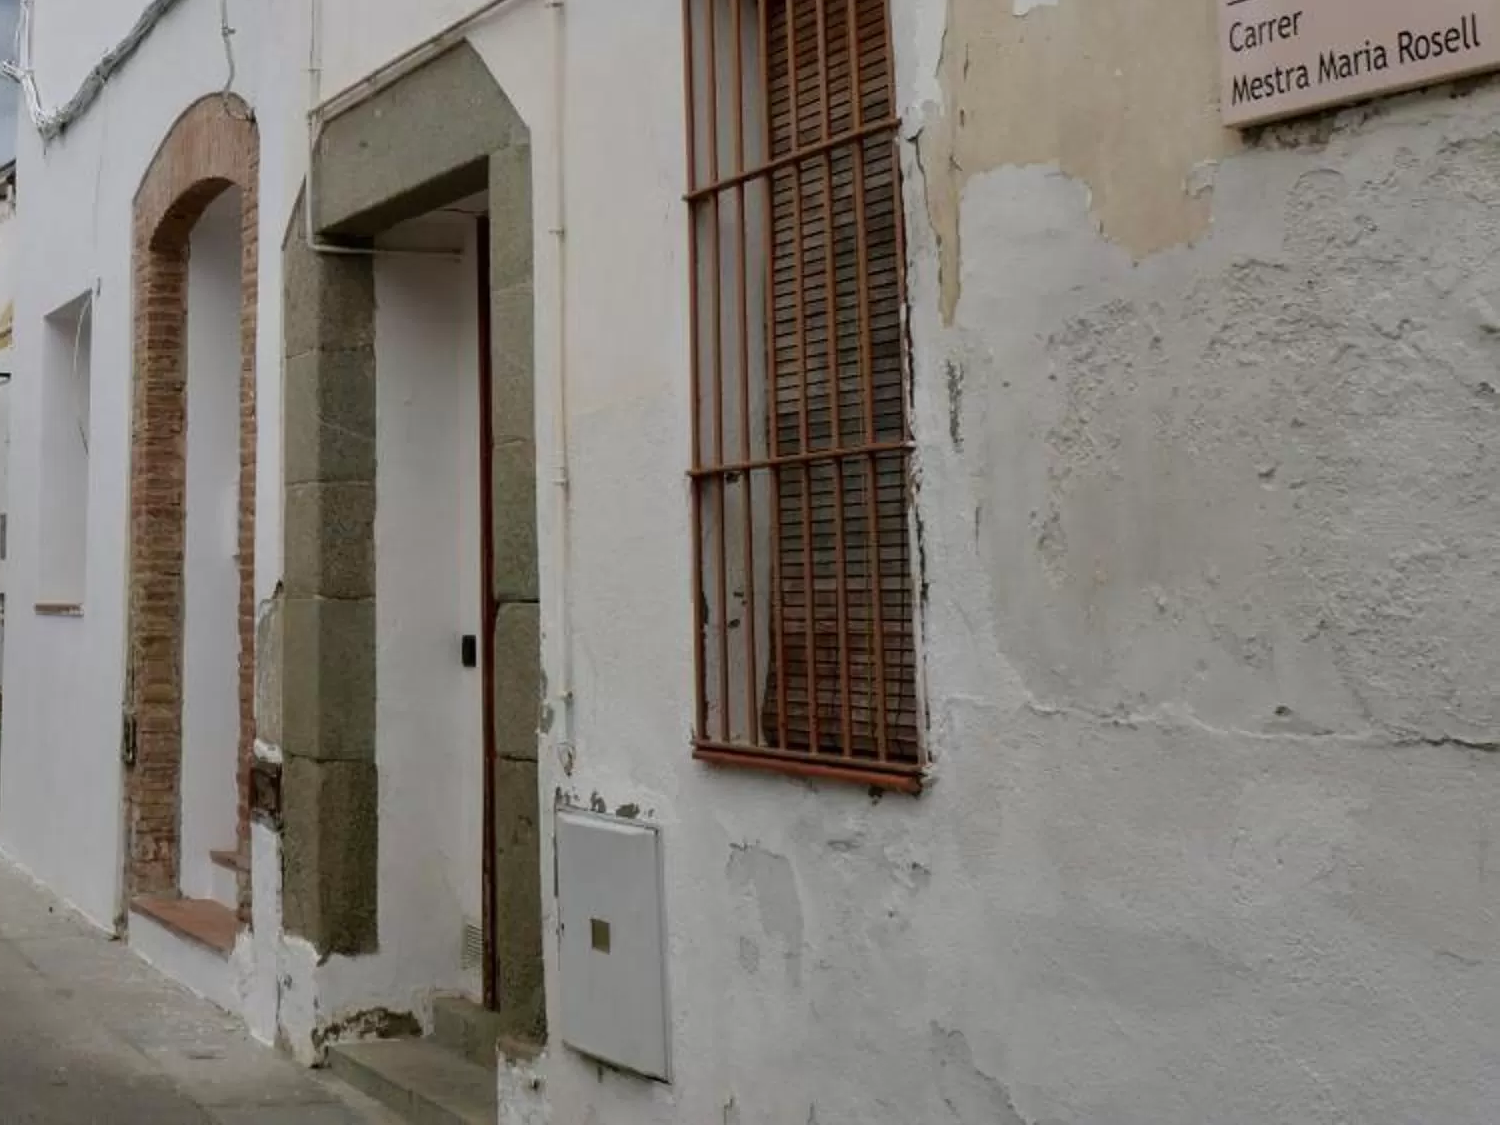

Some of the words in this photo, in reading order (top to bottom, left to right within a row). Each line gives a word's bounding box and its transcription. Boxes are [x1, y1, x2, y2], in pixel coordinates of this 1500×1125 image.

[1229, 11, 1304, 53] Carrer
[1231, 64, 1311, 107] Mestra
[1318, 39, 1389, 84] Maria
[1397, 12, 1481, 64] Rosell
